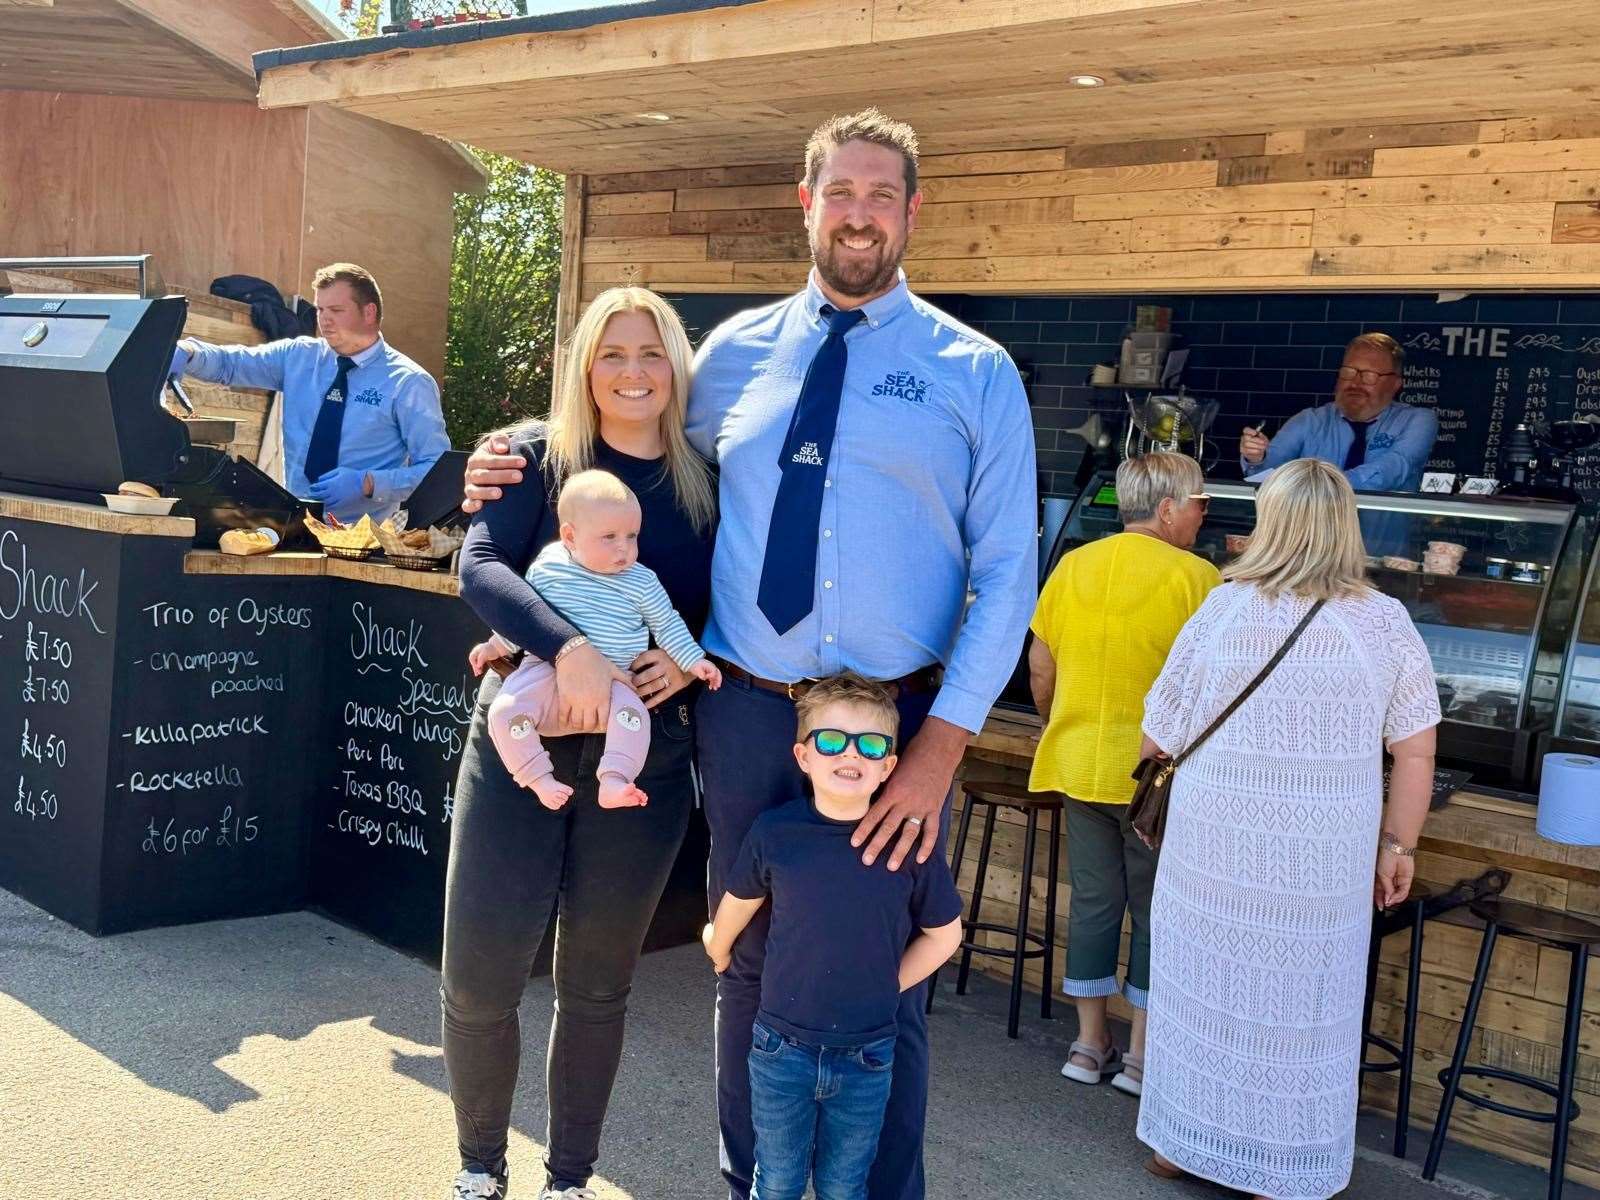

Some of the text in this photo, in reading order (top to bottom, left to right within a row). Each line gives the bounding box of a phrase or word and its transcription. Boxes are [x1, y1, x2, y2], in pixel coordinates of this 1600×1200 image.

[1442, 327, 1510, 357] THE
[872, 385, 926, 403] SHACK
[884, 374, 916, 388] SEA
[792, 455, 824, 466] SHACK
[799, 446, 819, 457] SEA
[0, 530, 107, 634] Shack
[143, 598, 312, 636] Trio of Oysters
[350, 601, 429, 667] Shack
[211, 674, 284, 699] poached
[344, 701, 402, 734] Chicken
[347, 738, 405, 770] Peri Peri
[342, 770, 382, 803] Texas
[386, 780, 427, 816] BBQ
[216, 805, 259, 847] £15
[338, 809, 429, 855] Crispy Chilli
